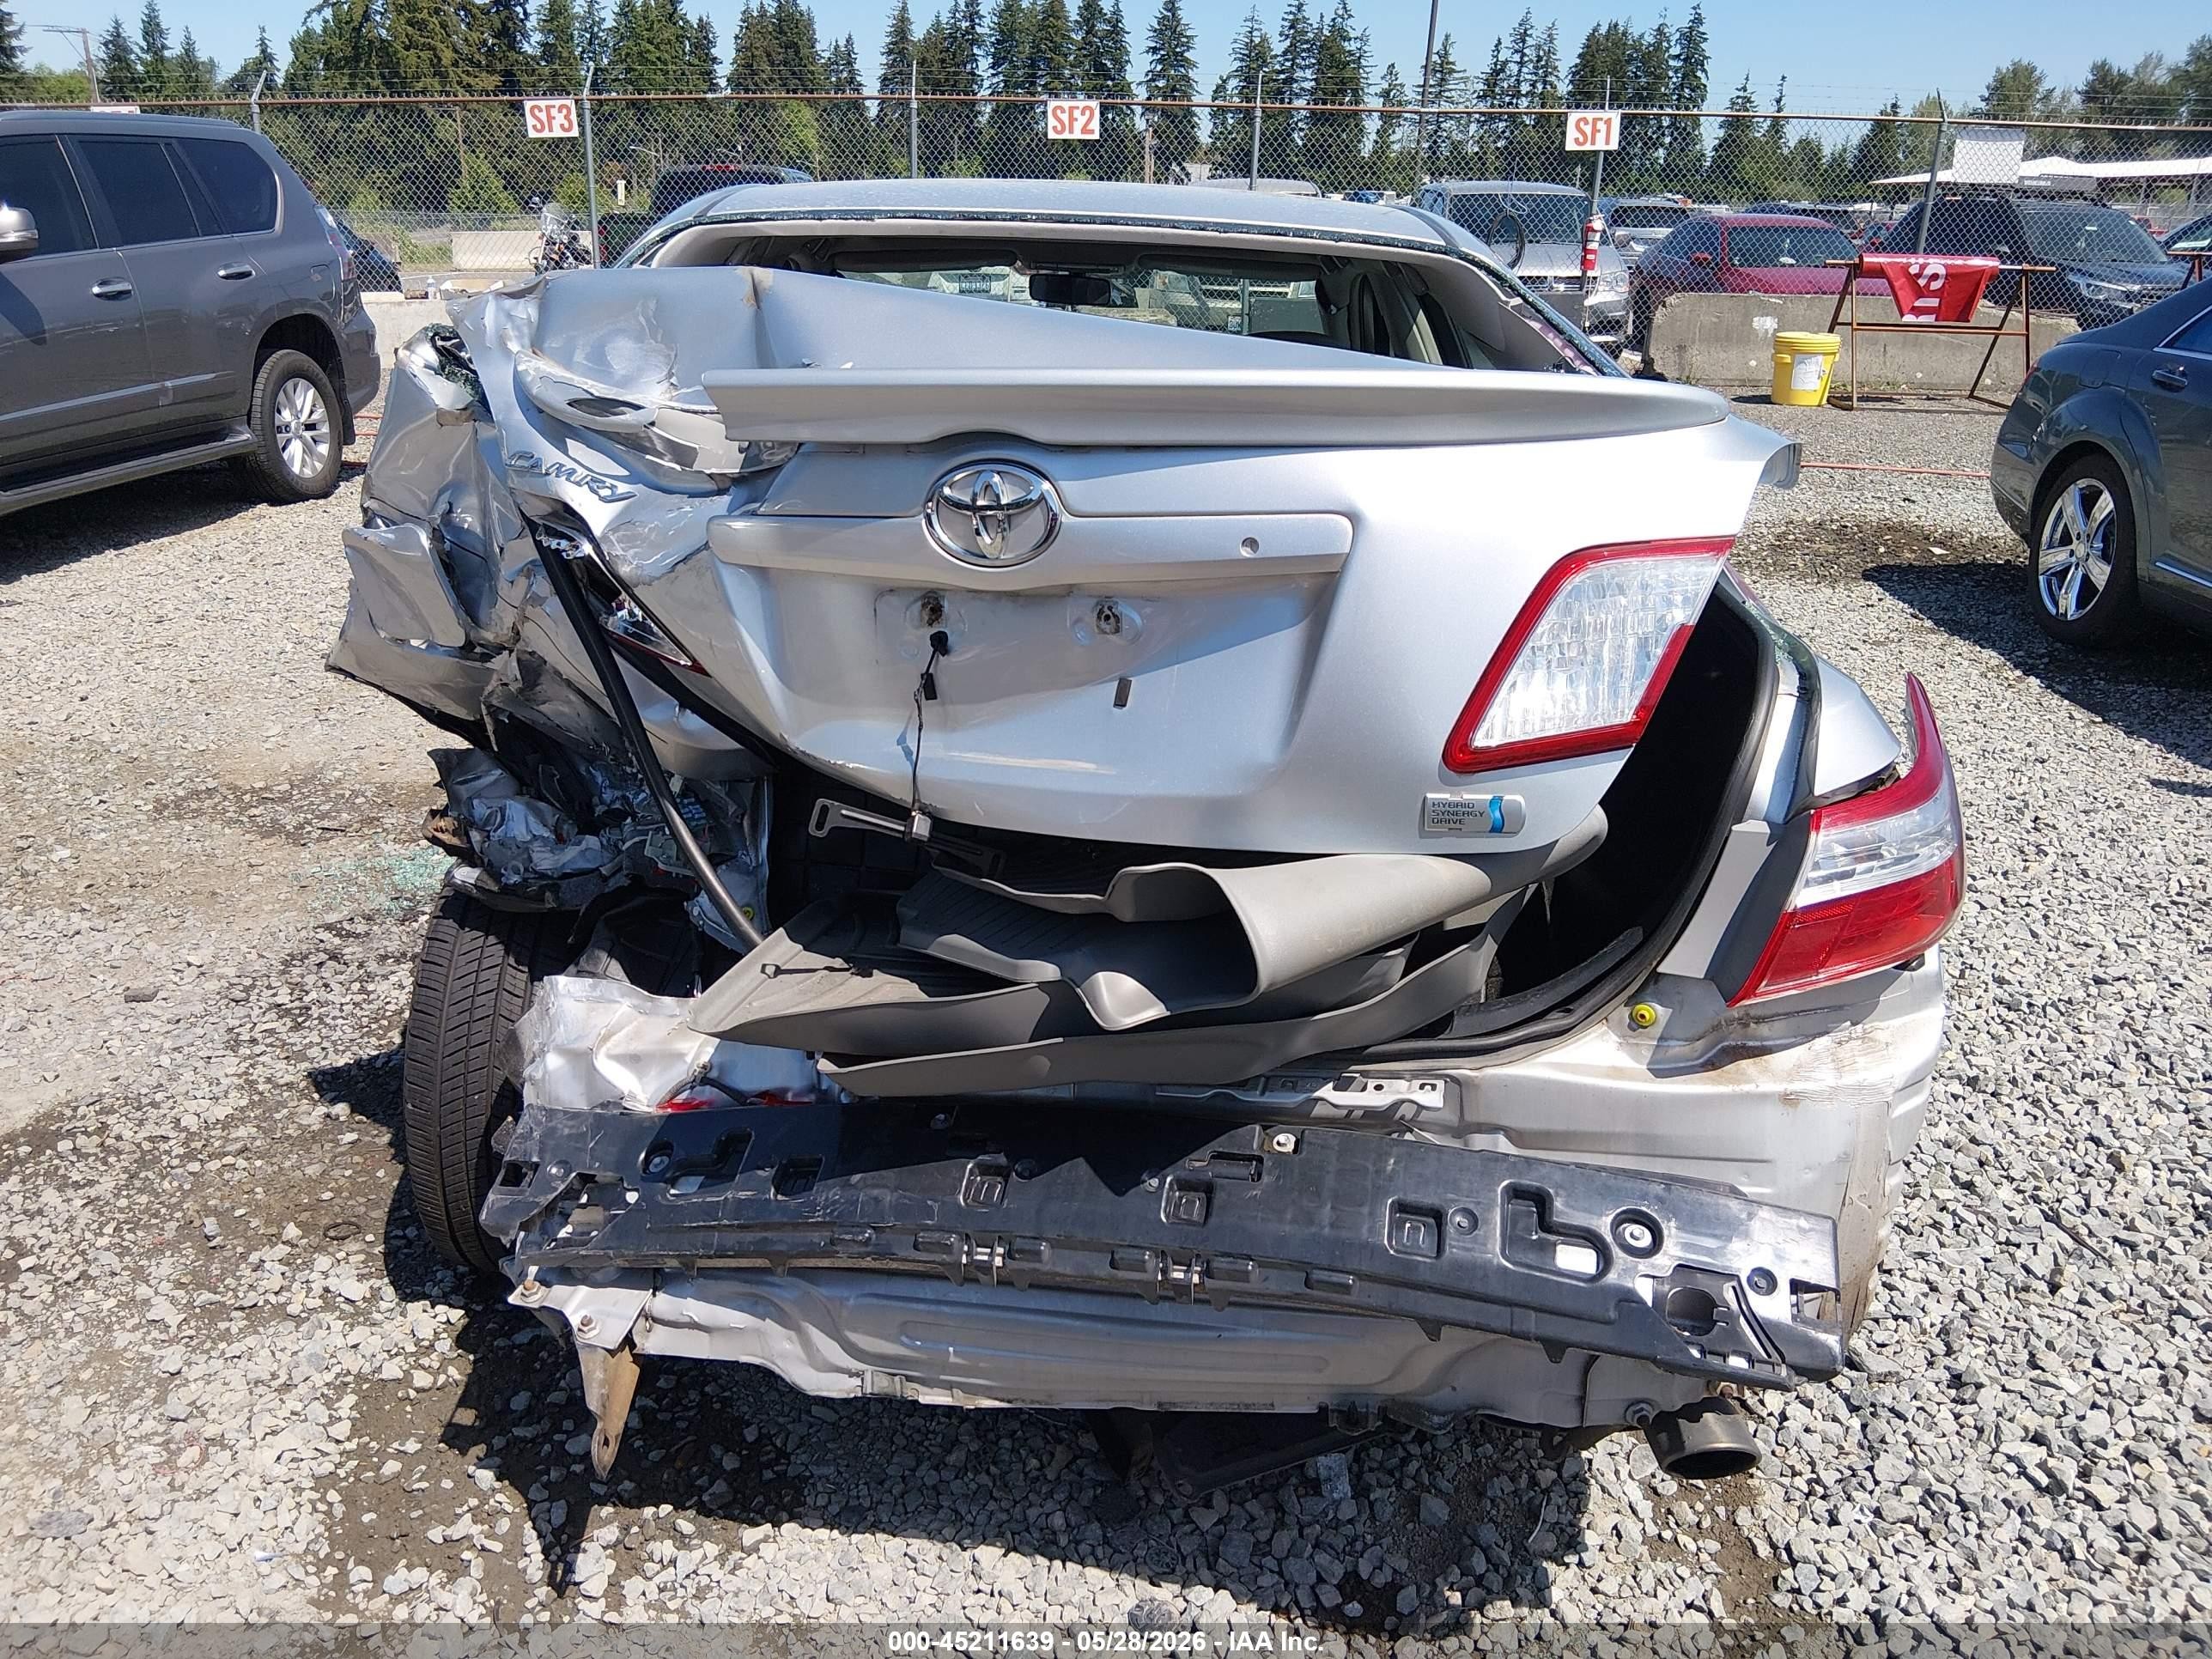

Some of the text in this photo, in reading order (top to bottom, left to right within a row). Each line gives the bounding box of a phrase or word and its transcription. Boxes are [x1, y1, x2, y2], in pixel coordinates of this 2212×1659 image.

[530, 104, 574, 133] SF3
[1052, 106, 1095, 135] SF2
[1574, 117, 1613, 146] SF1
